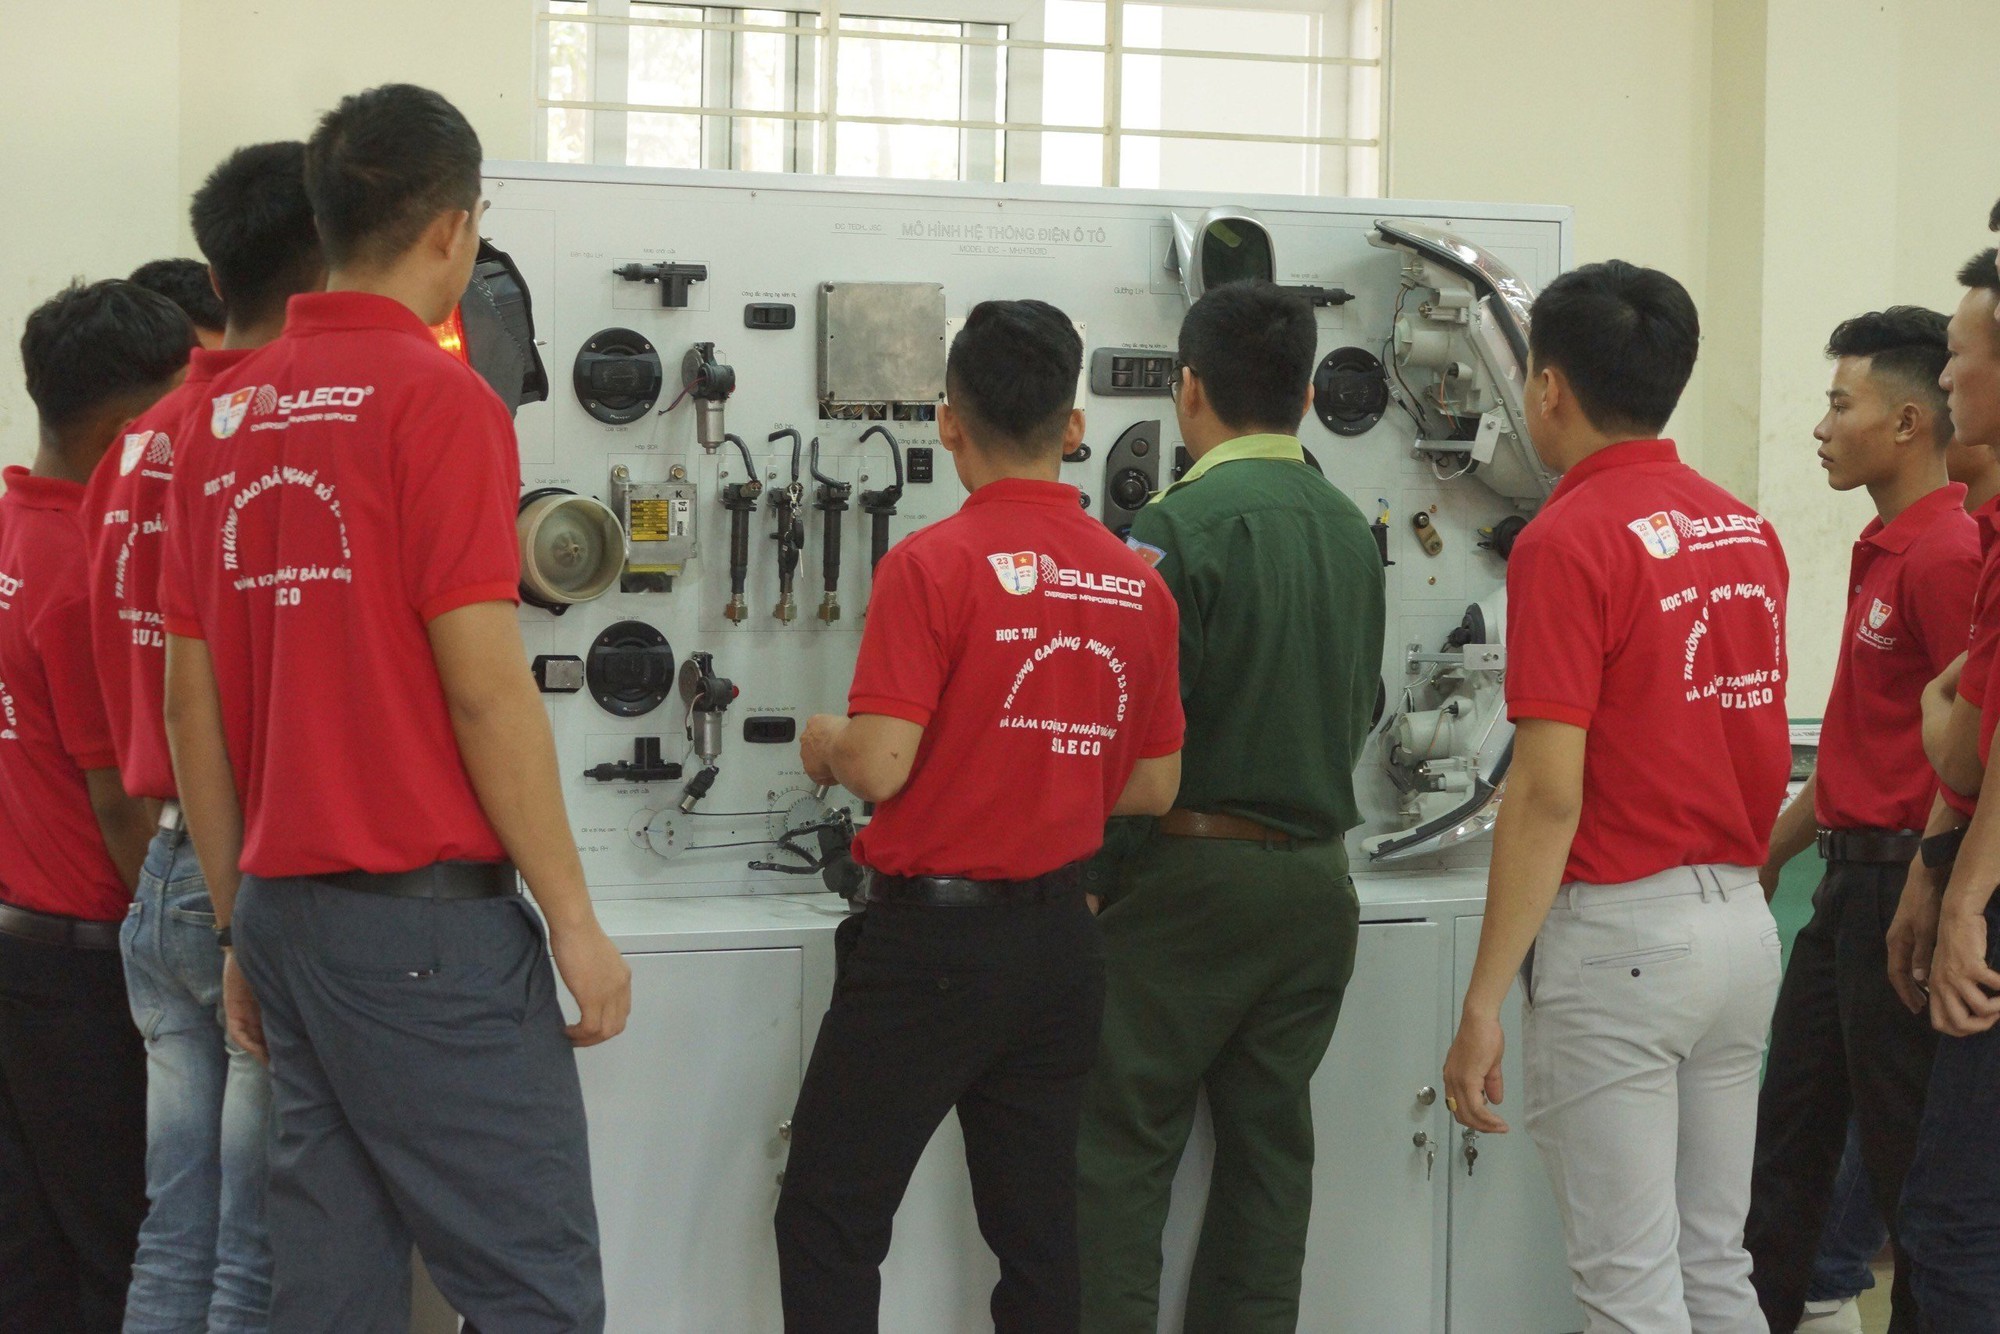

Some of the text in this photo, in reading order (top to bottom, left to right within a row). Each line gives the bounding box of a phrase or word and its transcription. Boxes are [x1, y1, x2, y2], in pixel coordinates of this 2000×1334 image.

[902, 219, 924, 236] MÔ
[927, 220, 960, 238] HÌNH
[964, 223, 984, 240] HỆ
[1038, 225, 1070, 243] ĐIỆN
[1073, 226, 1084, 242] Ô
[1087, 226, 1106, 243] TÔ
[234, 481, 262, 509] CAO
[314, 483, 336, 501] SỐ
[675, 490, 683, 498] K
[678, 501, 688, 513] E4
[1692, 513, 1761, 538] SULECO
[996, 557, 1009, 566] 23
[299, 563, 331, 582] BẢN
[1059, 568, 1143, 597] SULECO
[1044, 590, 1143, 611] OVERSEAS MANPOWER SERVICE
[1659, 592, 1682, 612] HỌC
[1681, 586, 1699, 603] TẠI
[995, 627, 1038, 643] HỌC TẠI
[1684, 619, 1708, 681] TRƯỜNG
[1764, 595, 1777, 613] SỐ
[1003, 657, 1034, 710] TRƯỜNG
[1108, 657, 1127, 674] SỐ
[1686, 686, 1701, 702] VÀ
[1011, 715, 1038, 730] LÀM
